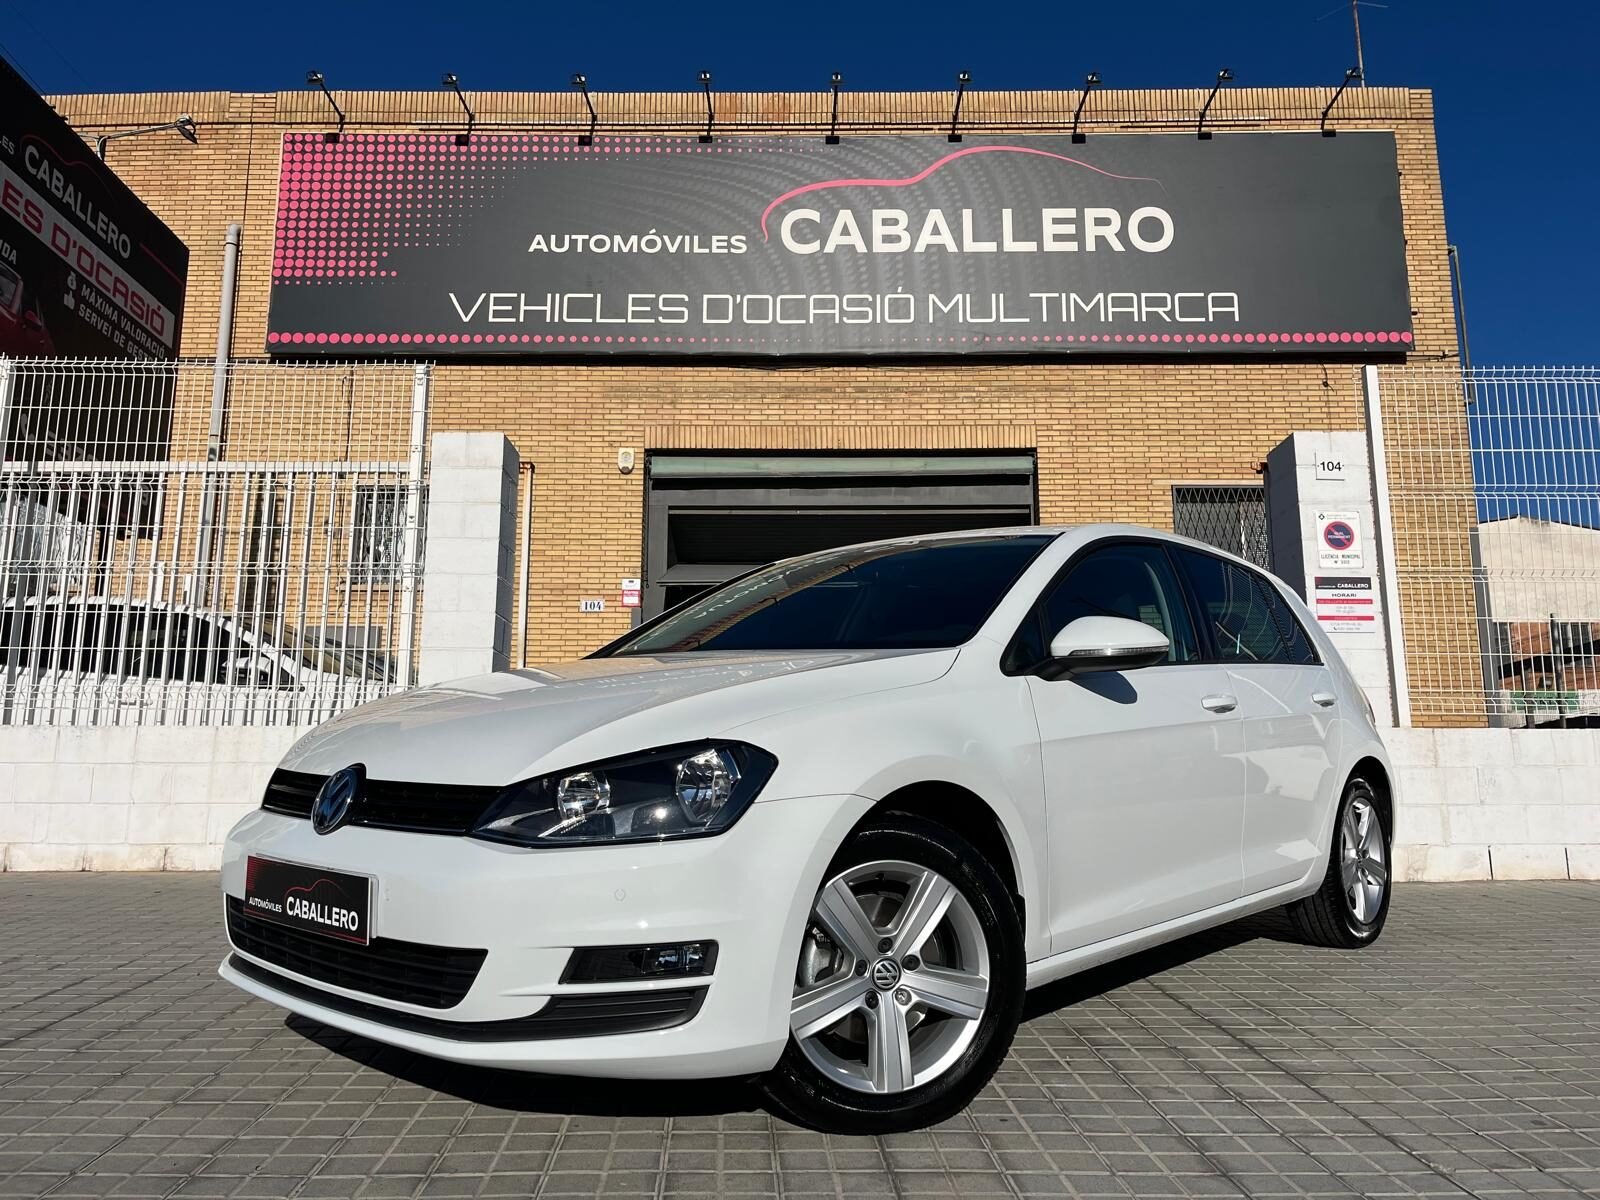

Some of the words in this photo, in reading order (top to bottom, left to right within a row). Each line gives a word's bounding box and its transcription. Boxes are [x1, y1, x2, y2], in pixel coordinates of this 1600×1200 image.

[0, 135, 15, 155] ES
[24, 145, 131, 259] CABALLERO
[528, 229, 748, 254] AUTOMÓVILES
[780, 206, 1175, 255] CABALLERO
[0, 178, 43, 234] ES
[51, 222, 165, 337] D'OCASIÓ
[78, 304, 112, 338] SERVEI
[113, 330, 126, 348] DE
[449, 292, 689, 324] VEHICLES
[702, 287, 915, 324] D'OCASIÓ
[928, 291, 1240, 323] MULTIMARCA
[121, 315, 165, 359] VALORACIÓ
[1319, 461, 1342, 472] 104
[584, 601, 601, 611] 104
[248, 896, 283, 913] AUTOMÓVILES
[286, 896, 359, 932] CABALLERO
